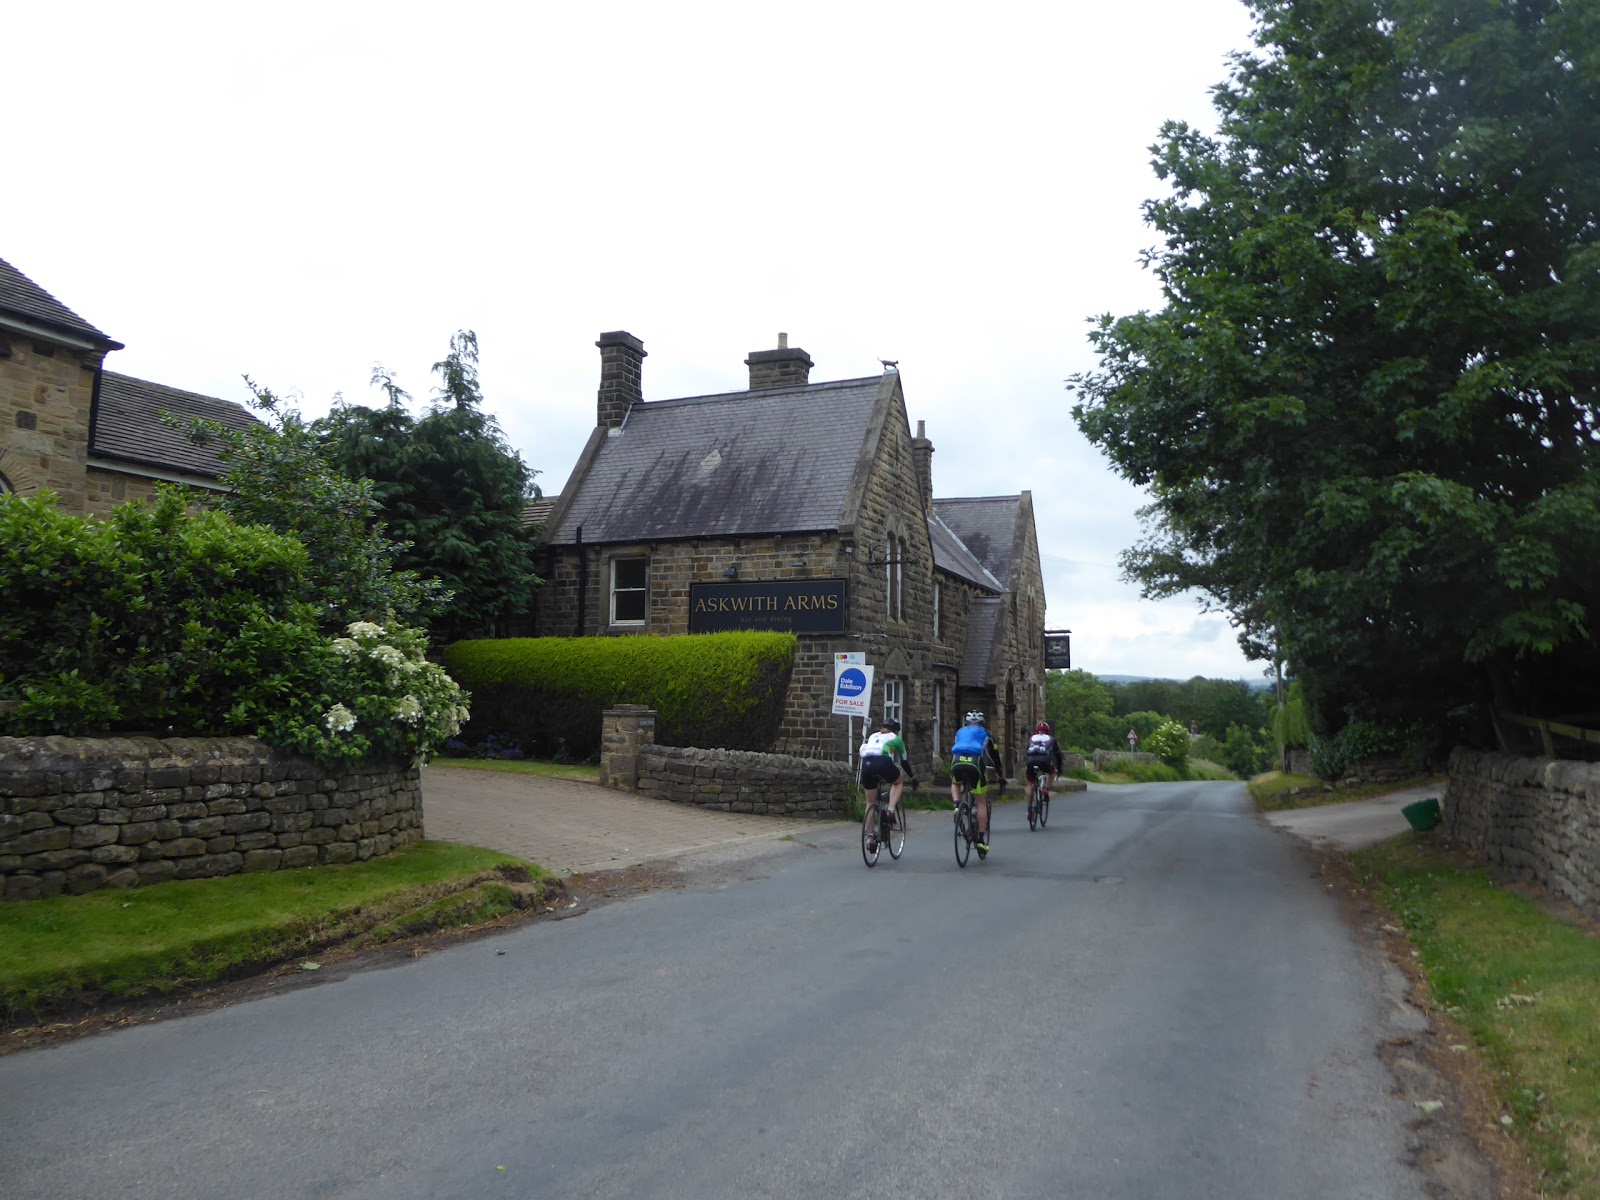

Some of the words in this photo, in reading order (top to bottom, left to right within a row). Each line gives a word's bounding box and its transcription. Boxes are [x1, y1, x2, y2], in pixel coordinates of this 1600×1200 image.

[695, 597, 777, 612] ASKWITH
[784, 594, 838, 610] ARMS
[769, 615, 793, 624] dining
